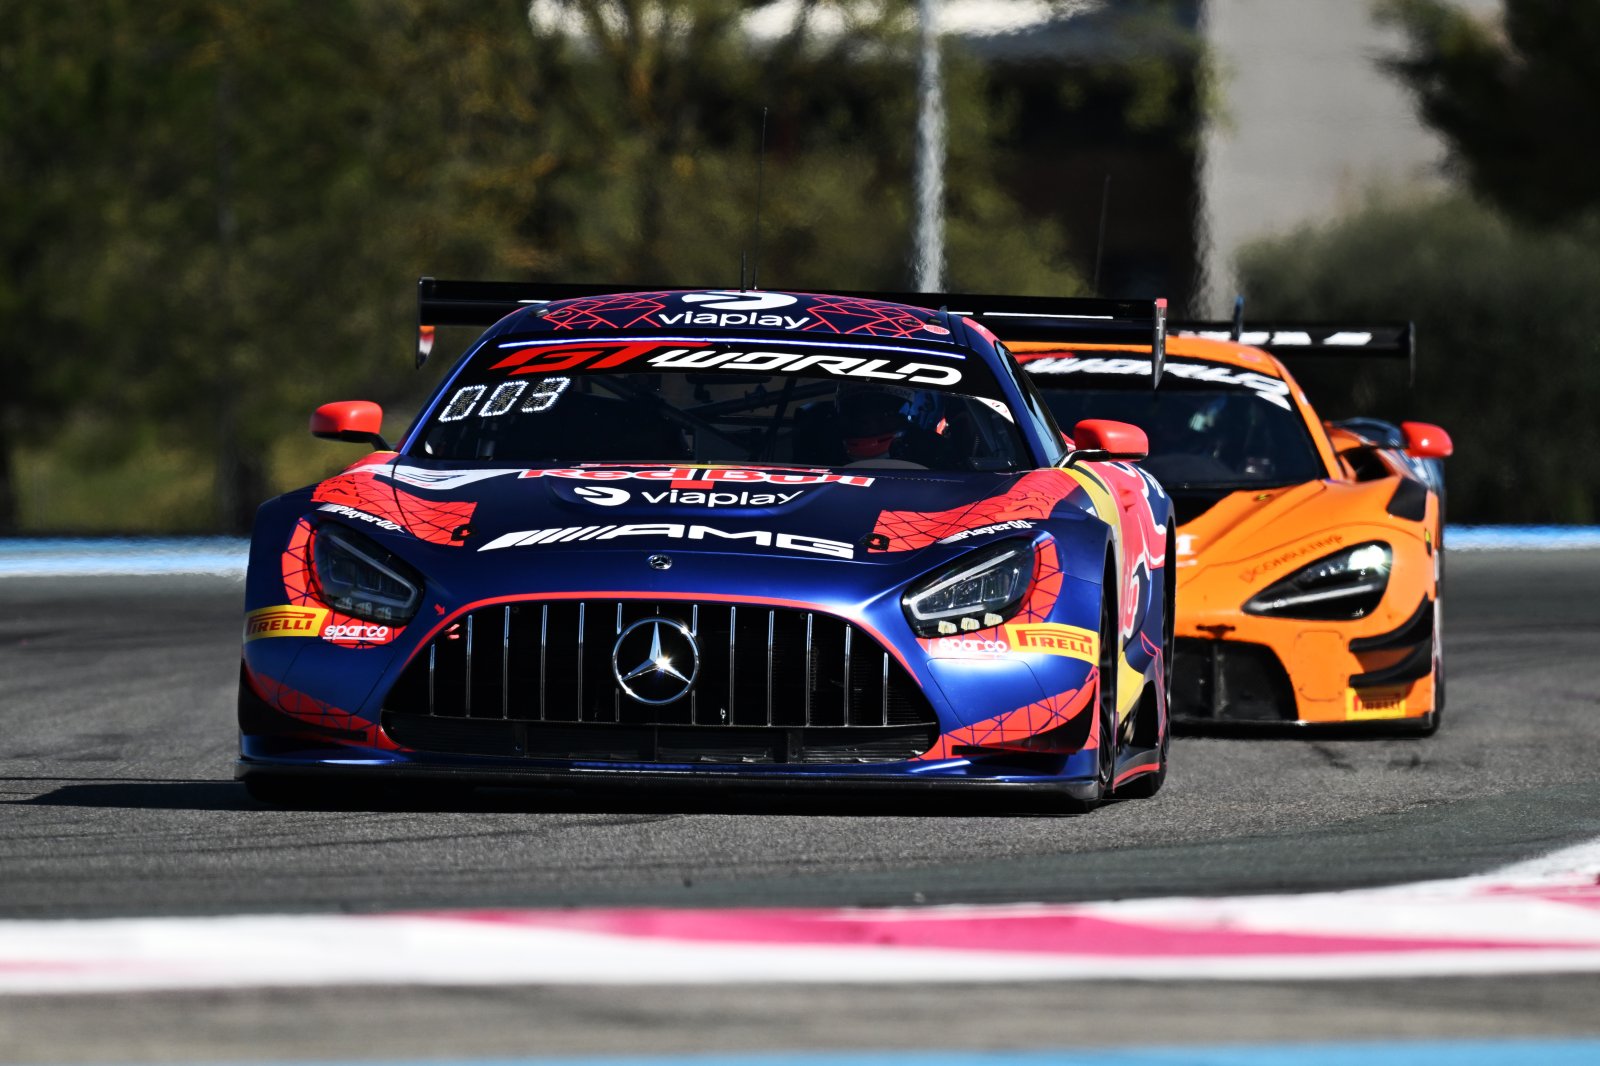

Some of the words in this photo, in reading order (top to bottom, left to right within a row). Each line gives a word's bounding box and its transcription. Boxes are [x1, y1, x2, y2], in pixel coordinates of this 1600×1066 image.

[659, 310, 810, 330] viaplay
[489, 341, 712, 376] GT
[647, 349, 962, 386] WORLD
[517, 468, 697, 480] Red
[702, 469, 875, 487] Bull
[641, 489, 803, 507] viaplay
[597, 523, 853, 559] AMG
[247, 611, 316, 635] PIRELLI
[324, 625, 388, 640] sparco
[1016, 629, 1093, 656] PIRELLI
